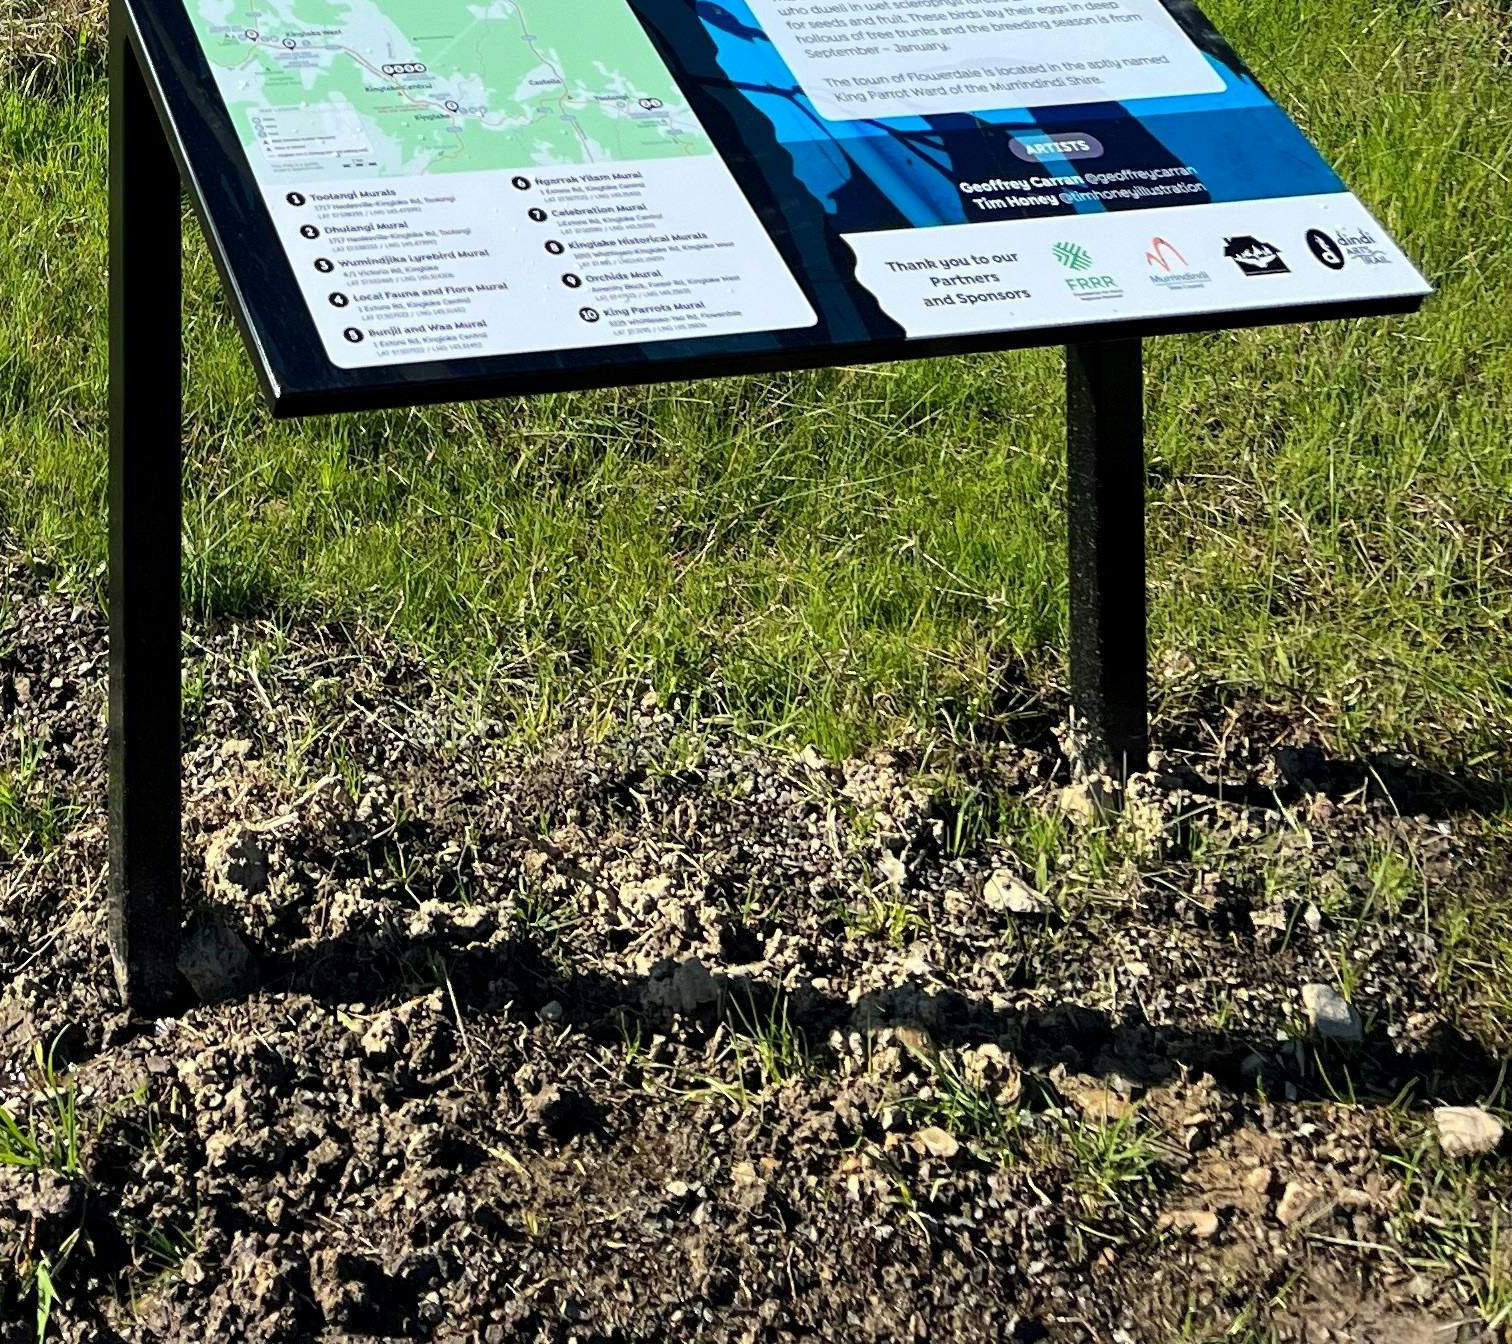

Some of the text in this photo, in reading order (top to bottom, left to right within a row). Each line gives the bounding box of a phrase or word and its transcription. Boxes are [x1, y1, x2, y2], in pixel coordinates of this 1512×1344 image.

[778, 6, 808, 16] who
[810, 2, 848, 14] dwell
[864, 0, 892, 11] wet
[786, 20, 805, 29] for
[808, 17, 848, 28] seeds
[849, 15, 876, 26] and
[876, 14, 909, 24] fruit.
[907, 13, 947, 22] These
[947, 9, 982, 19] birds
[982, 8, 1004, 18] lay
[1003, 6, 1034, 16] their
[1037, 4, 1069, 15] eggs
[1085, 1, 1119, 10] deep
[795, 33, 850, 44] hollows
[866, 31, 894, 39] tree
[895, 27, 938, 38] trunks
[940, 24, 966, 35] and
[966, 24, 989, 33] the
[990, 19, 1052, 31] breeding
[1052, 17, 1097, 27] season
[1109, 13, 1143, 22] from
[805, 46, 879, 58] September
[893, 42, 952, 53] January.
[823, 77, 851, 87] The
[852, 76, 889, 86] town
[907, 68, 982, 81] Flowerdale
[995, 63, 1047, 75] located
[1061, 61, 1085, 70] the
[1087, 59, 1122, 69] aptly
[1121, 55, 1170, 65] named
[834, 92, 867, 102] King
[867, 88, 910, 99] Parrot
[910, 85, 947, 96] Ward
[964, 83, 988, 93] the
[989, 76, 1066, 91] Murrindindi
[1066, 75, 1105, 85] Shire.
[1024, 139, 1090, 155] ARTISTS
[960, 165, 1199, 193] Geoffrey Carran @geoffreycarran
[973, 181, 1208, 209] Tim Honey @timhoneyillustration
[1336, 226, 1376, 247] dindi
[885, 253, 1017, 271] Thank you to our
[930, 273, 1000, 286] Partners
[1064, 275, 1119, 291] FRRR
[924, 289, 1031, 306] and Sponsors
